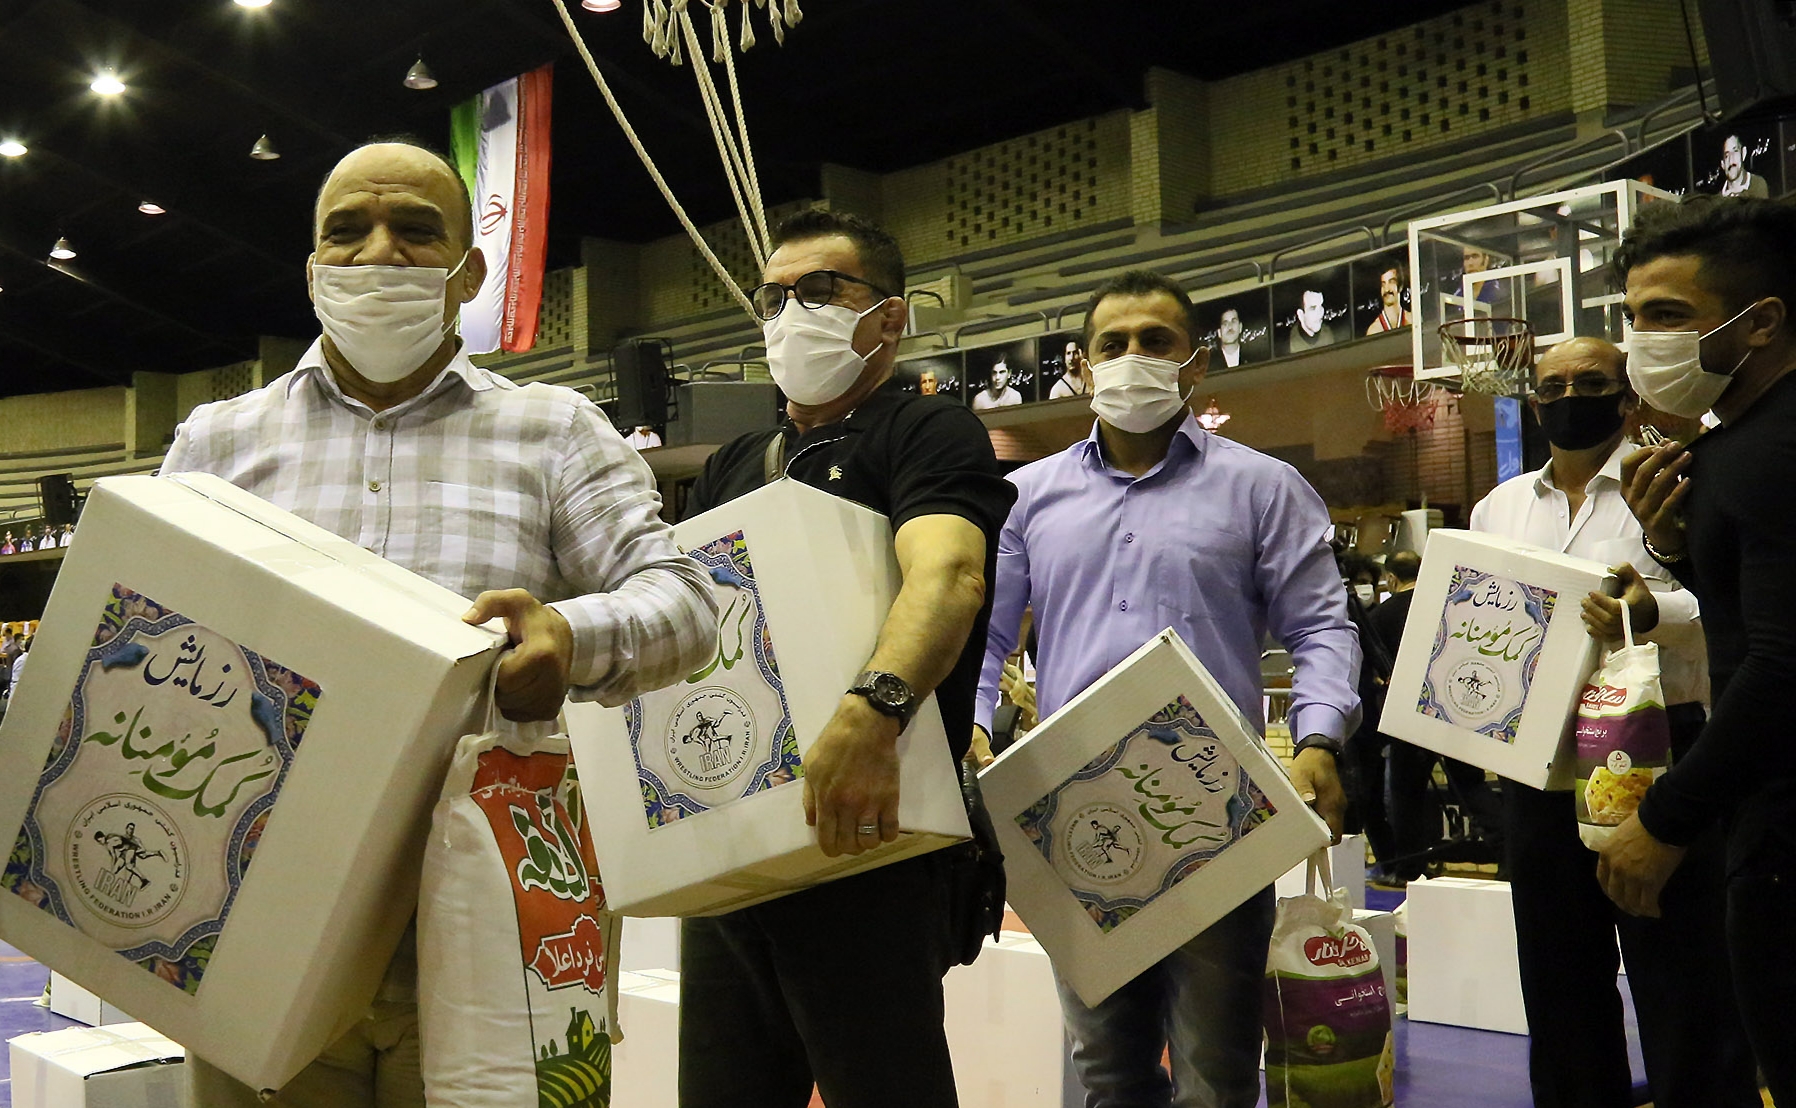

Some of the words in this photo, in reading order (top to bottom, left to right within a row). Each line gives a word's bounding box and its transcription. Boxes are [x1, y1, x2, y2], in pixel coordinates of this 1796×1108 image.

[1473, 581, 1518, 611] رزمایش
[143, 634, 238, 708] رزمایش
[699, 746, 733, 773] IRAN
[1171, 744, 1229, 793] رزمایش
[72, 843, 89, 895] WRESTLING
[89, 895, 141, 919] FEDERATION
[154, 893, 172, 911] IRAN
[93, 867, 138, 908] IRAN
